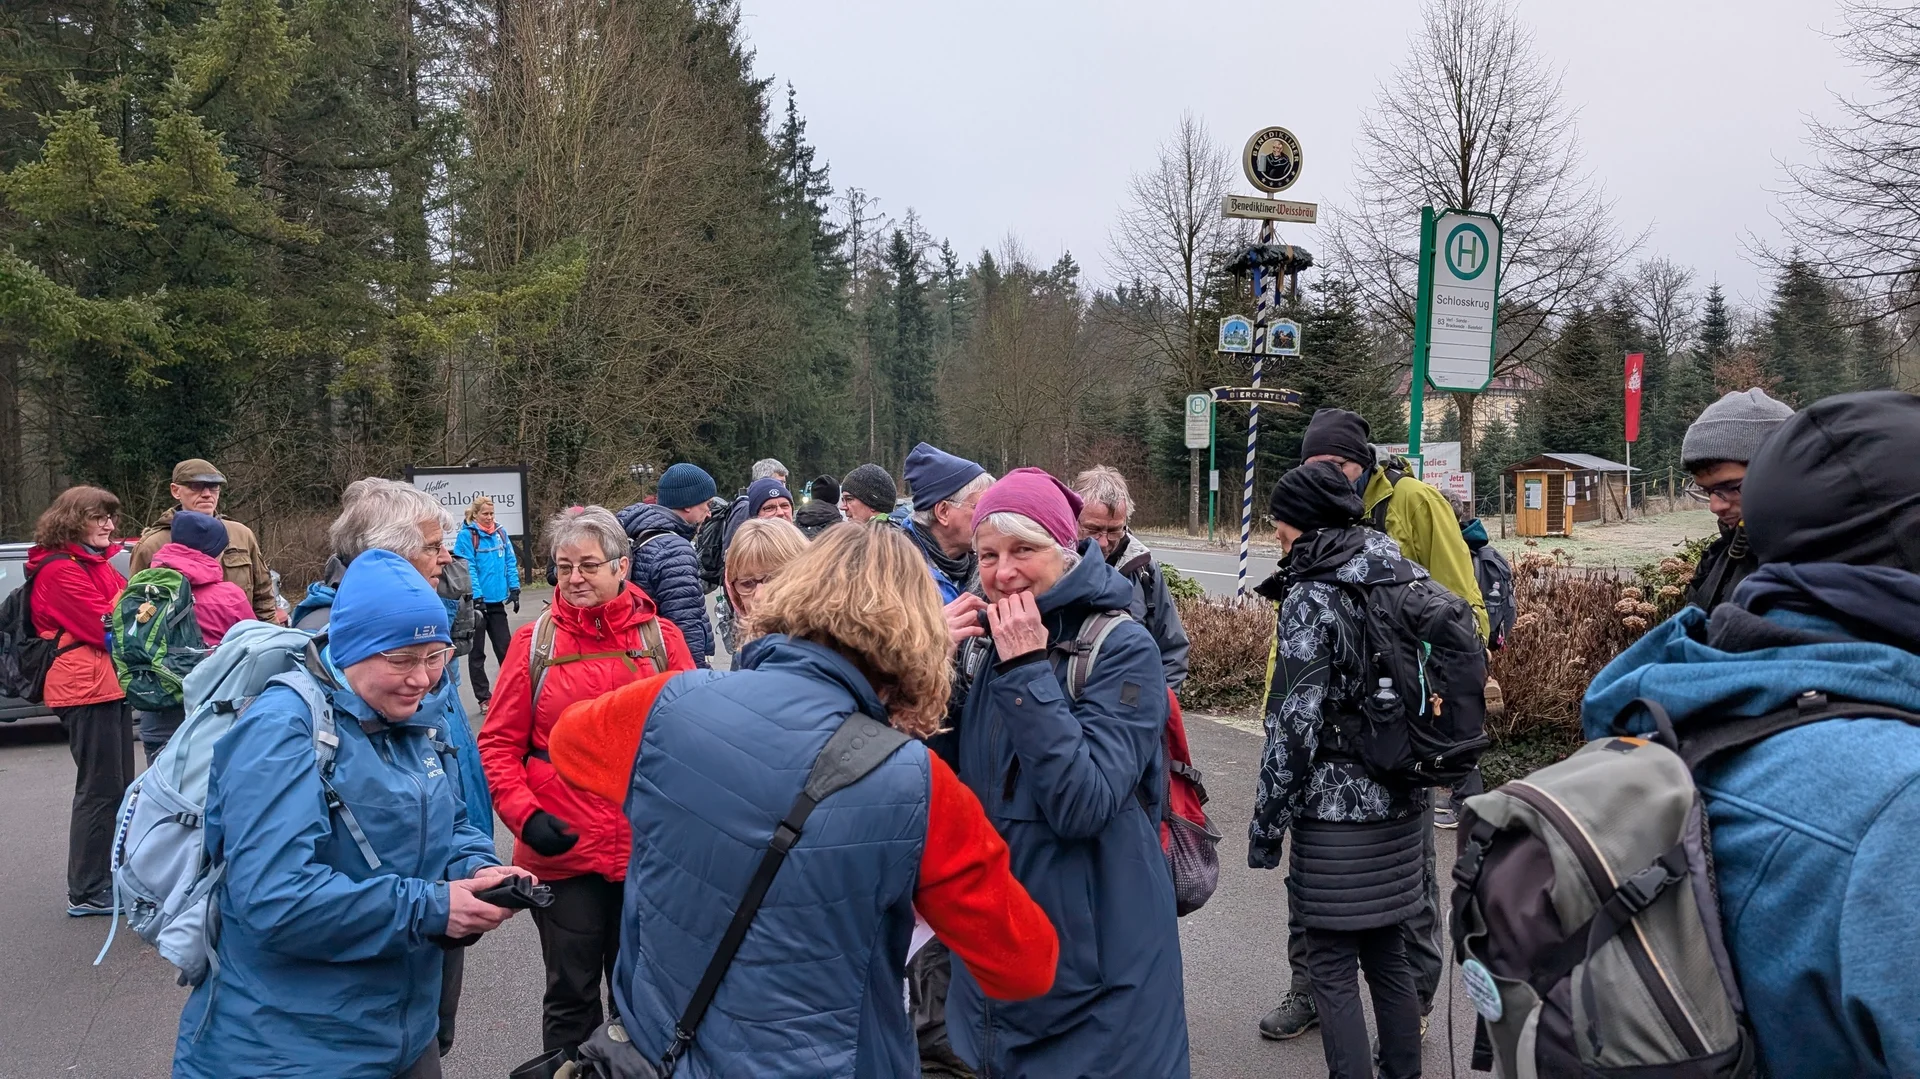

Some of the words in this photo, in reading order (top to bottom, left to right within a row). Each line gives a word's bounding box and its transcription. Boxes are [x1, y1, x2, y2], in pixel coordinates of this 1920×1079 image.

[1457, 234, 1477, 269] H
[1436, 294, 1490, 310] Schlosskrug
[1229, 391, 1287, 400] BIERGARTEN
[1449, 474, 1465, 482] Jetzt
[414, 625, 437, 637] LEX
